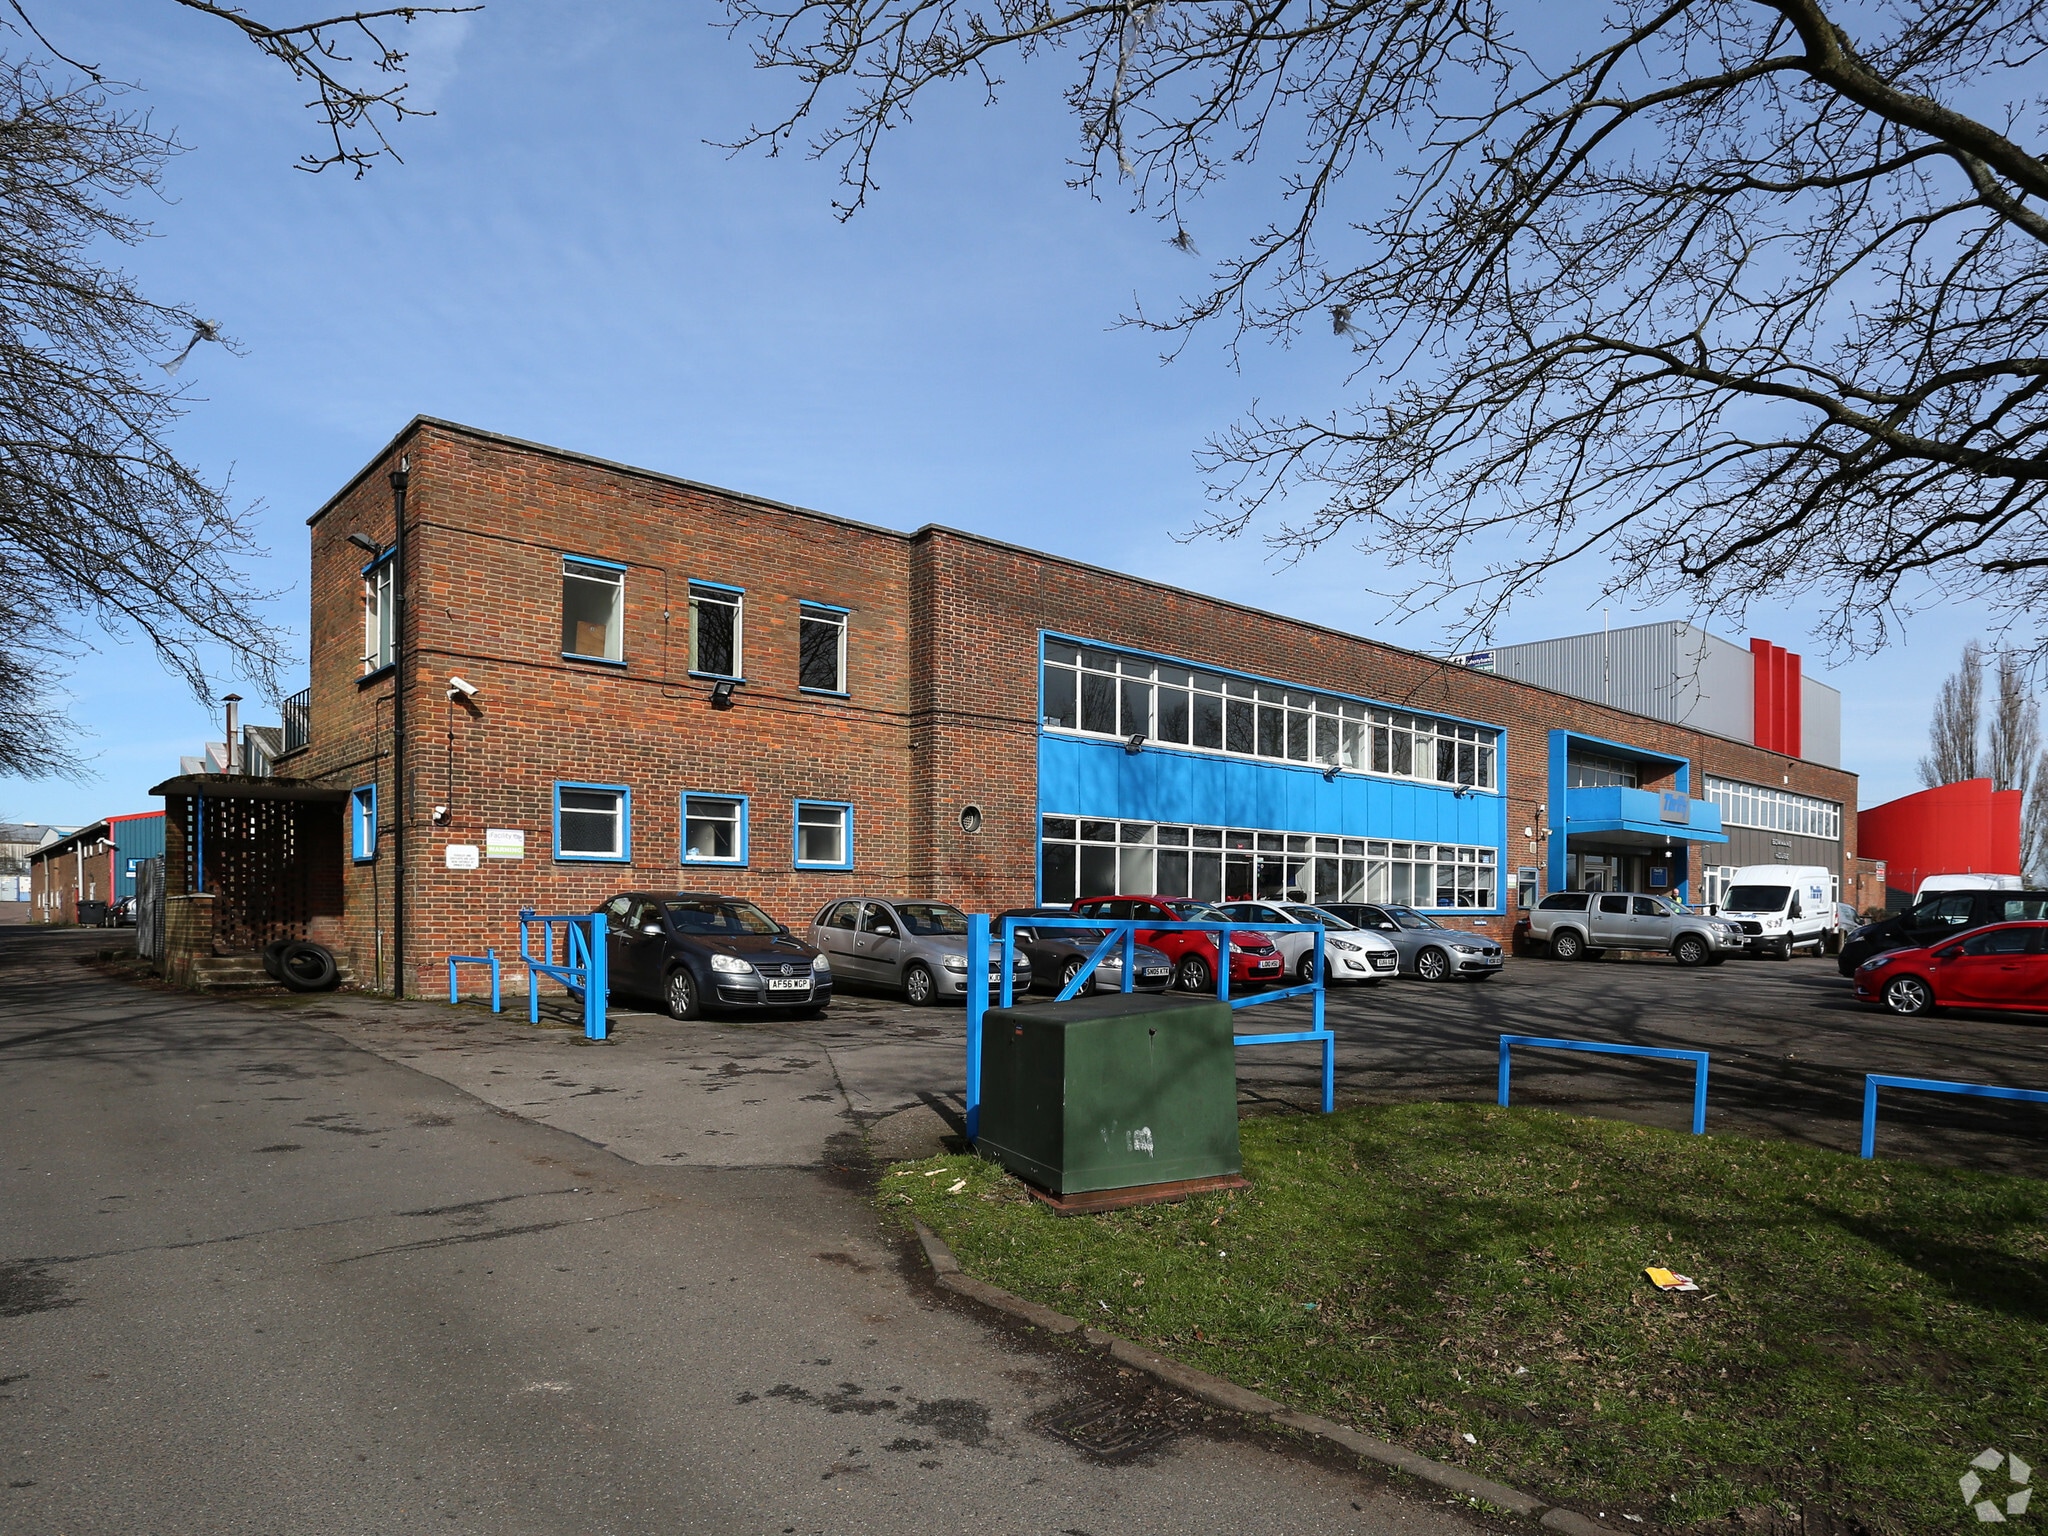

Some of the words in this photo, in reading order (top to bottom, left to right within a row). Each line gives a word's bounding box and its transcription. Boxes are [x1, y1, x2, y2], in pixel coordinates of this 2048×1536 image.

[488, 846, 523, 854] WARNING
[772, 980, 793, 989] AF56
[794, 979, 808, 989] WGP
